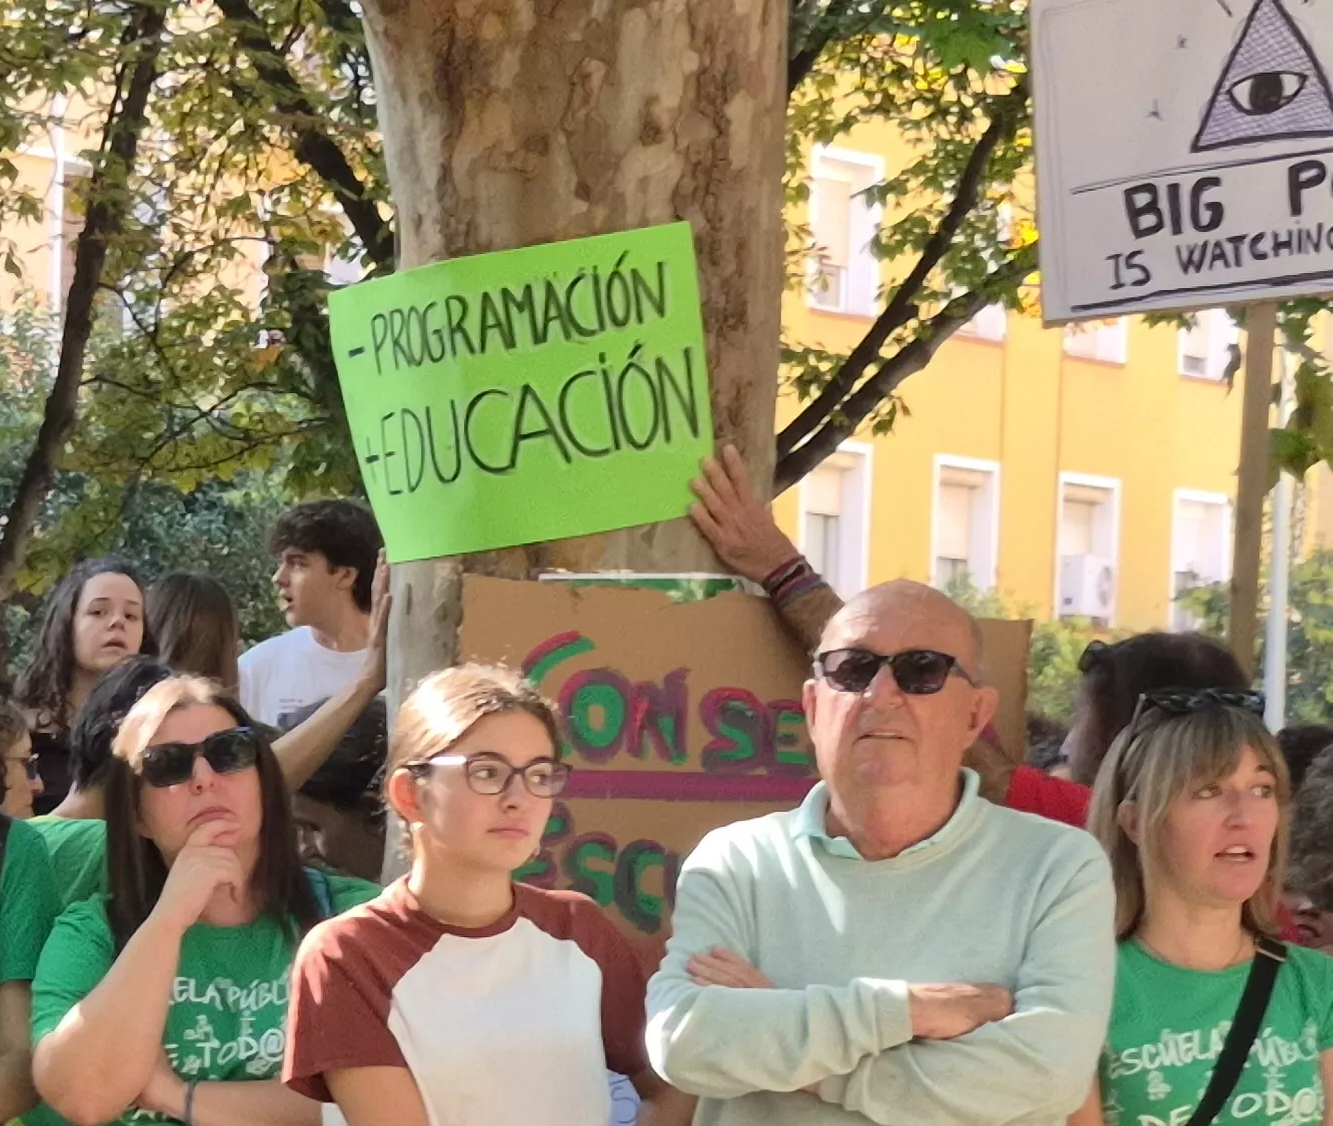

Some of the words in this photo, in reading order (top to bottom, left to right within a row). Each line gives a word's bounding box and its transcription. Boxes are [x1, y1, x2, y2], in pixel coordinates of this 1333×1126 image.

[1123, 176, 1225, 240] BIG
[1287, 160, 1333, 217] P
[1105, 250, 1152, 290] IS
[701, 687, 816, 776] SE
[196, 1028, 285, 1068] TOD@
